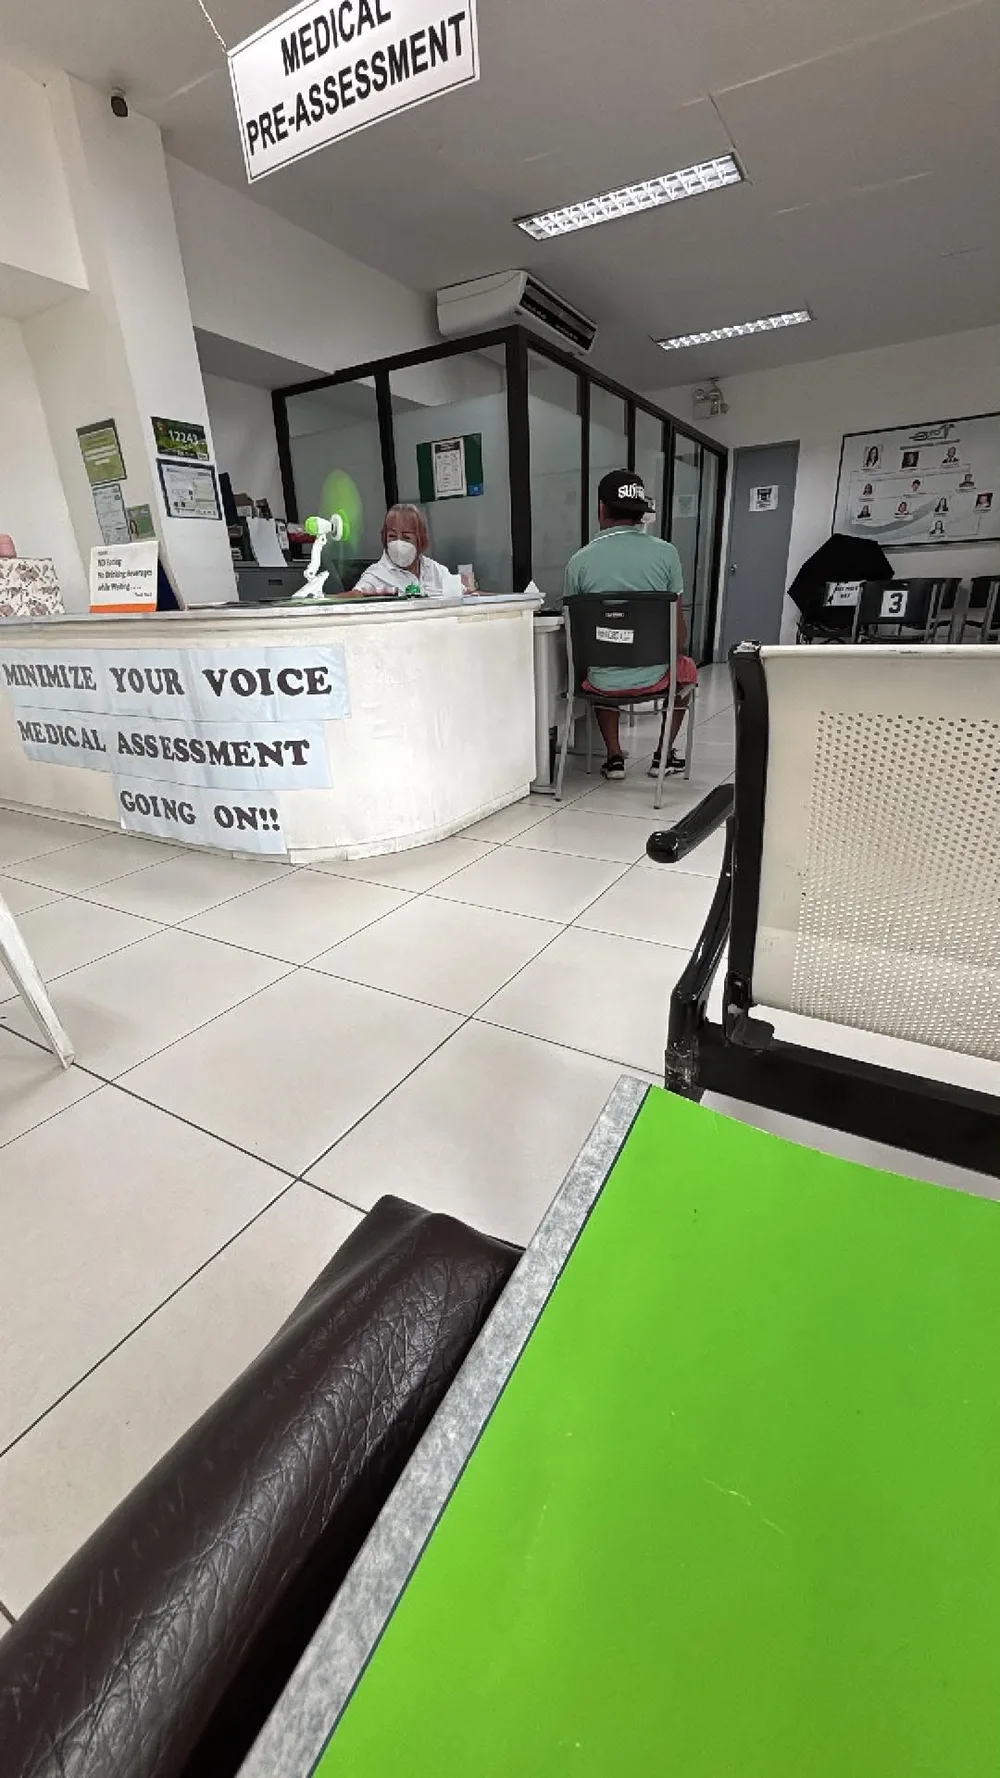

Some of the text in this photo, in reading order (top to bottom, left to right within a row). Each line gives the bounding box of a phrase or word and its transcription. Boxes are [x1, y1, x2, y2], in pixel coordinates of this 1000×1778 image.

[280, 0, 392, 76] MEDICAL
[246, 10, 466, 156] PRE-ASSESSMENT
[888, 592, 904, 614] 3
[2, 663, 333, 697] MINIMIZE YOUR VOICE
[16, 719, 310, 768] MEDICAL ASSESSMENT
[119, 789, 281, 832] GOING ON!!
